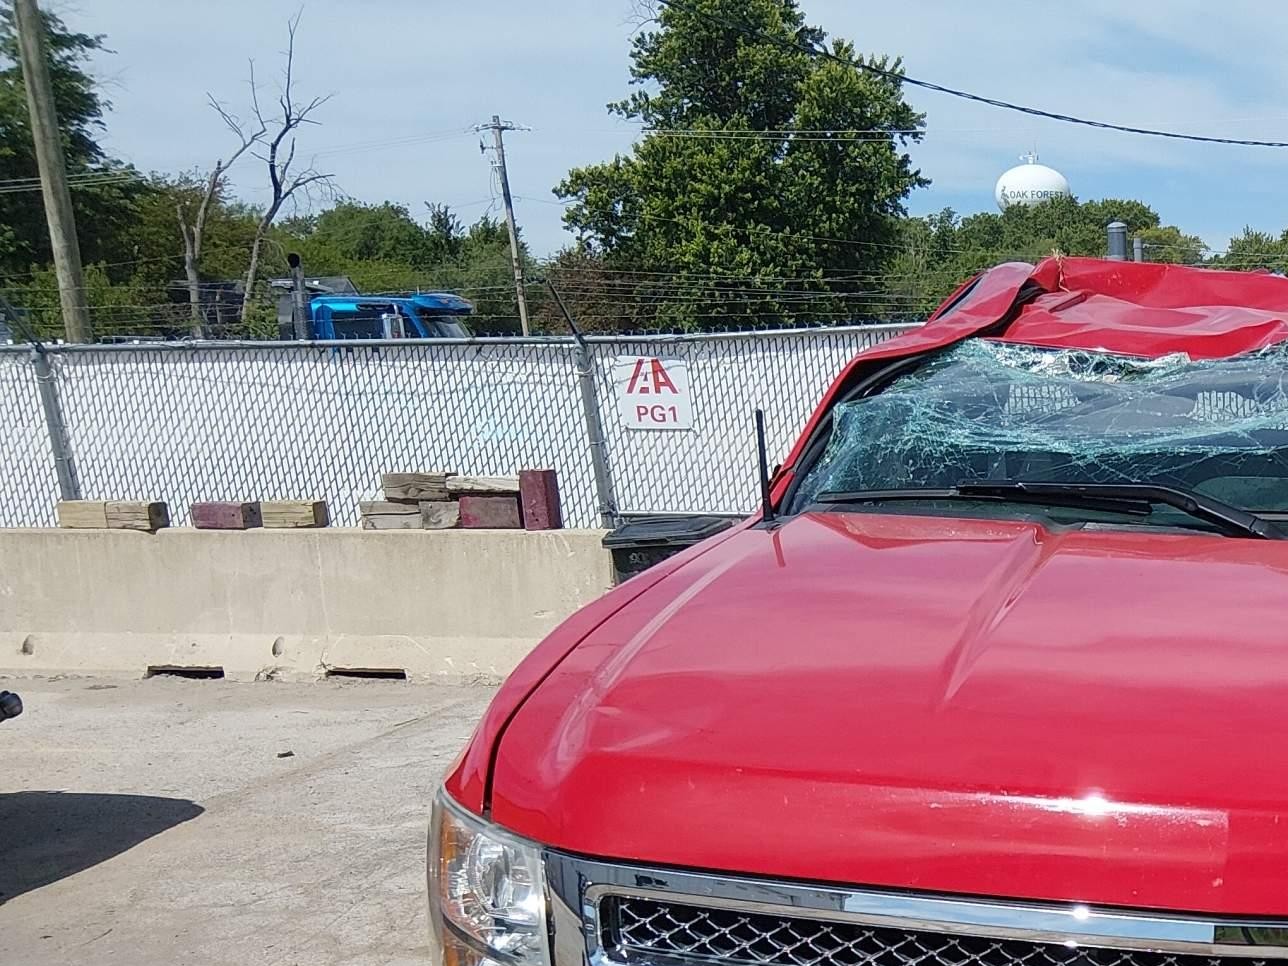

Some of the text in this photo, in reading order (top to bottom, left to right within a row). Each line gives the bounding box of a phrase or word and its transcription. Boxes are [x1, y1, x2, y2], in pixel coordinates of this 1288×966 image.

[1009, 190, 1064, 200] OAK FOREST
[636, 405, 678, 422] PG1
